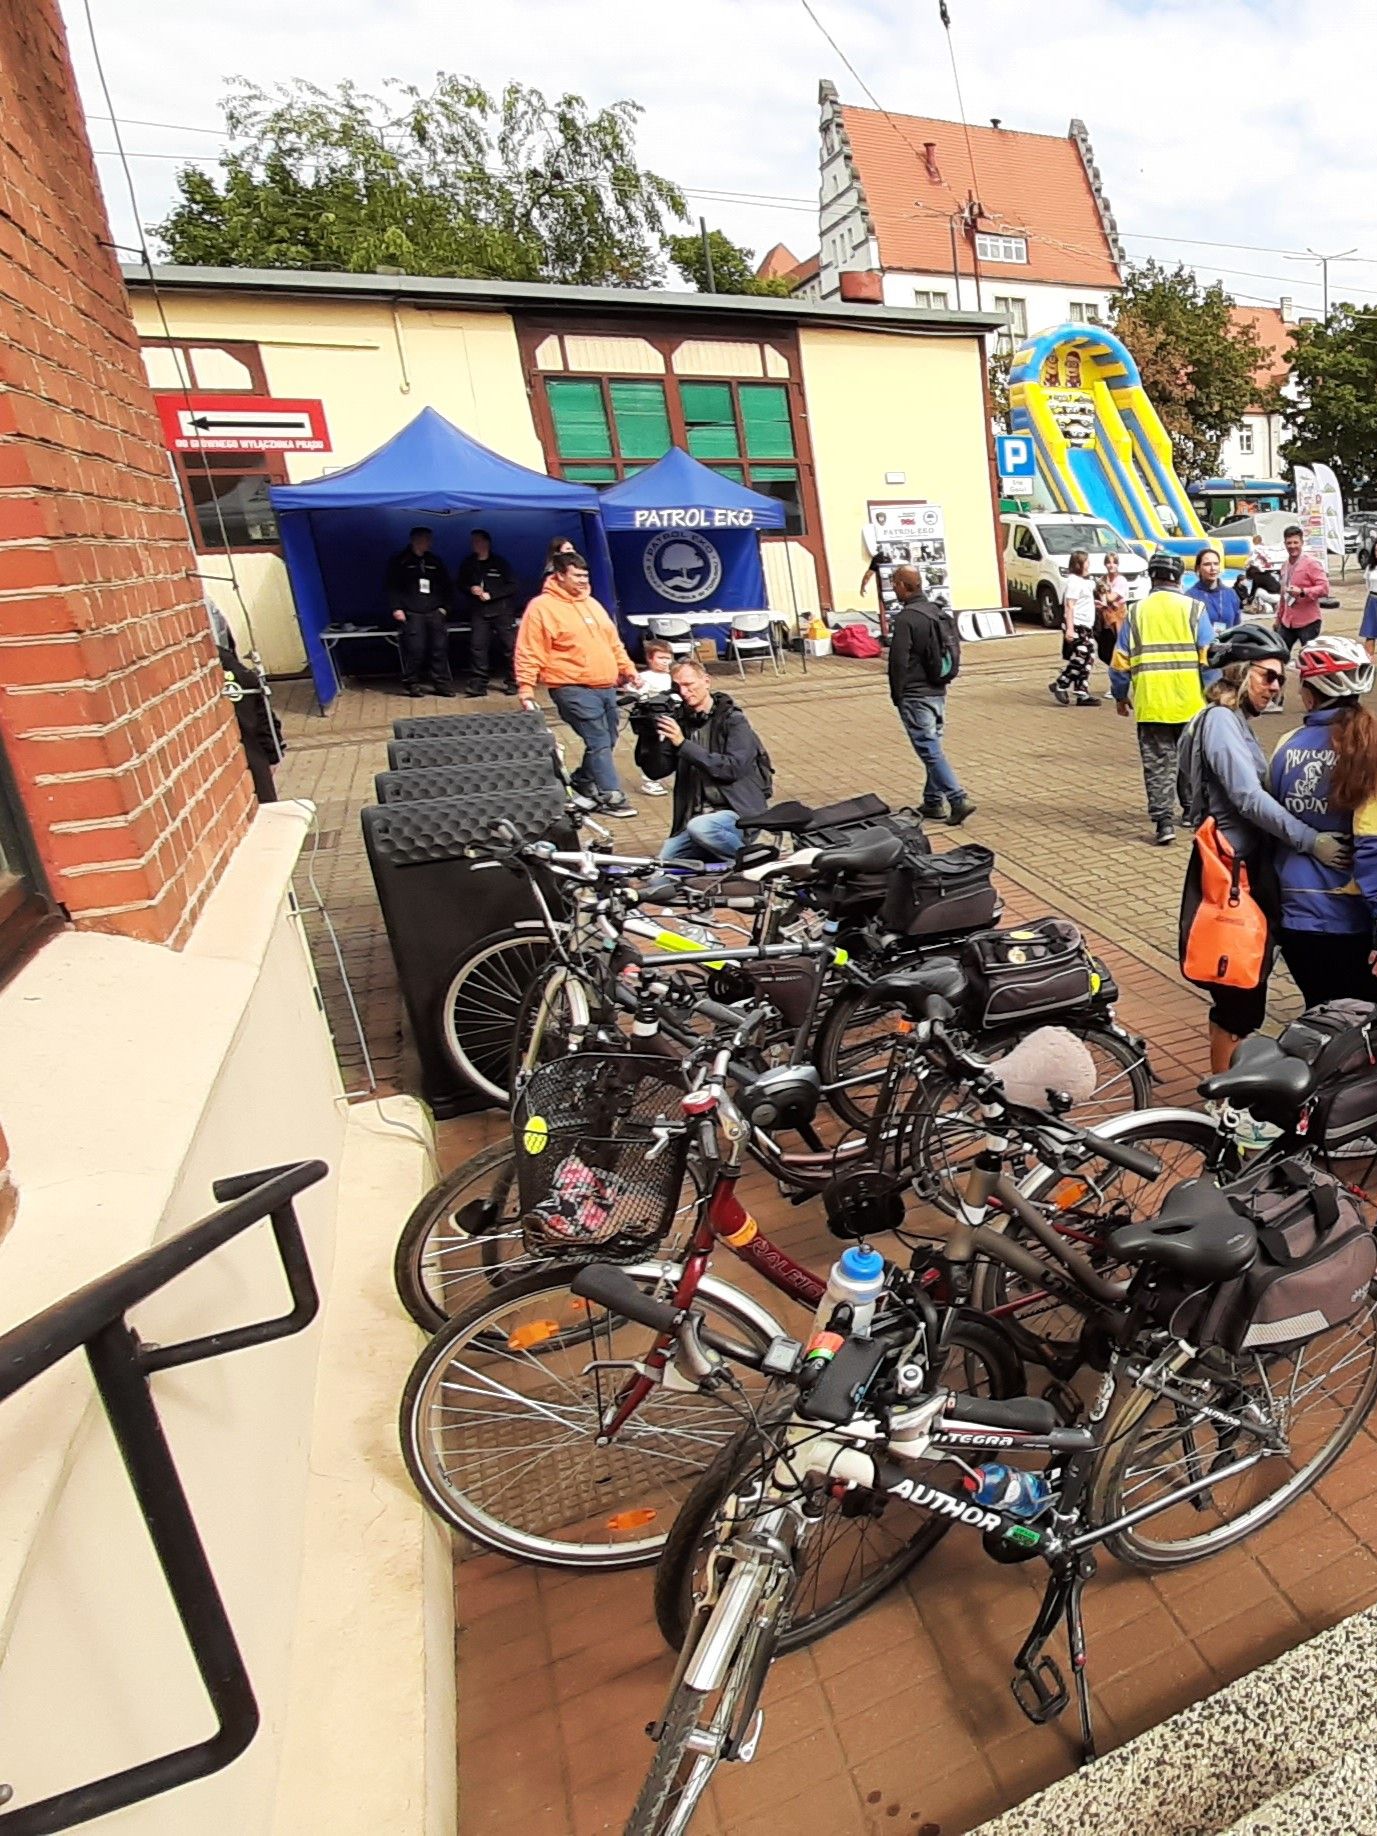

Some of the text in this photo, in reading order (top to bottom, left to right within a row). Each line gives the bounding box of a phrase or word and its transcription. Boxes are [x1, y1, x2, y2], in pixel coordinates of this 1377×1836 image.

[1003, 439, 1028, 473] P
[634, 508, 753, 528] PATROL EKO
[747, 1236, 826, 1299] RALEIG
[1200, 1406, 1242, 1426] AUTHOR
[886, 1478, 1002, 1532] AUTHOR
